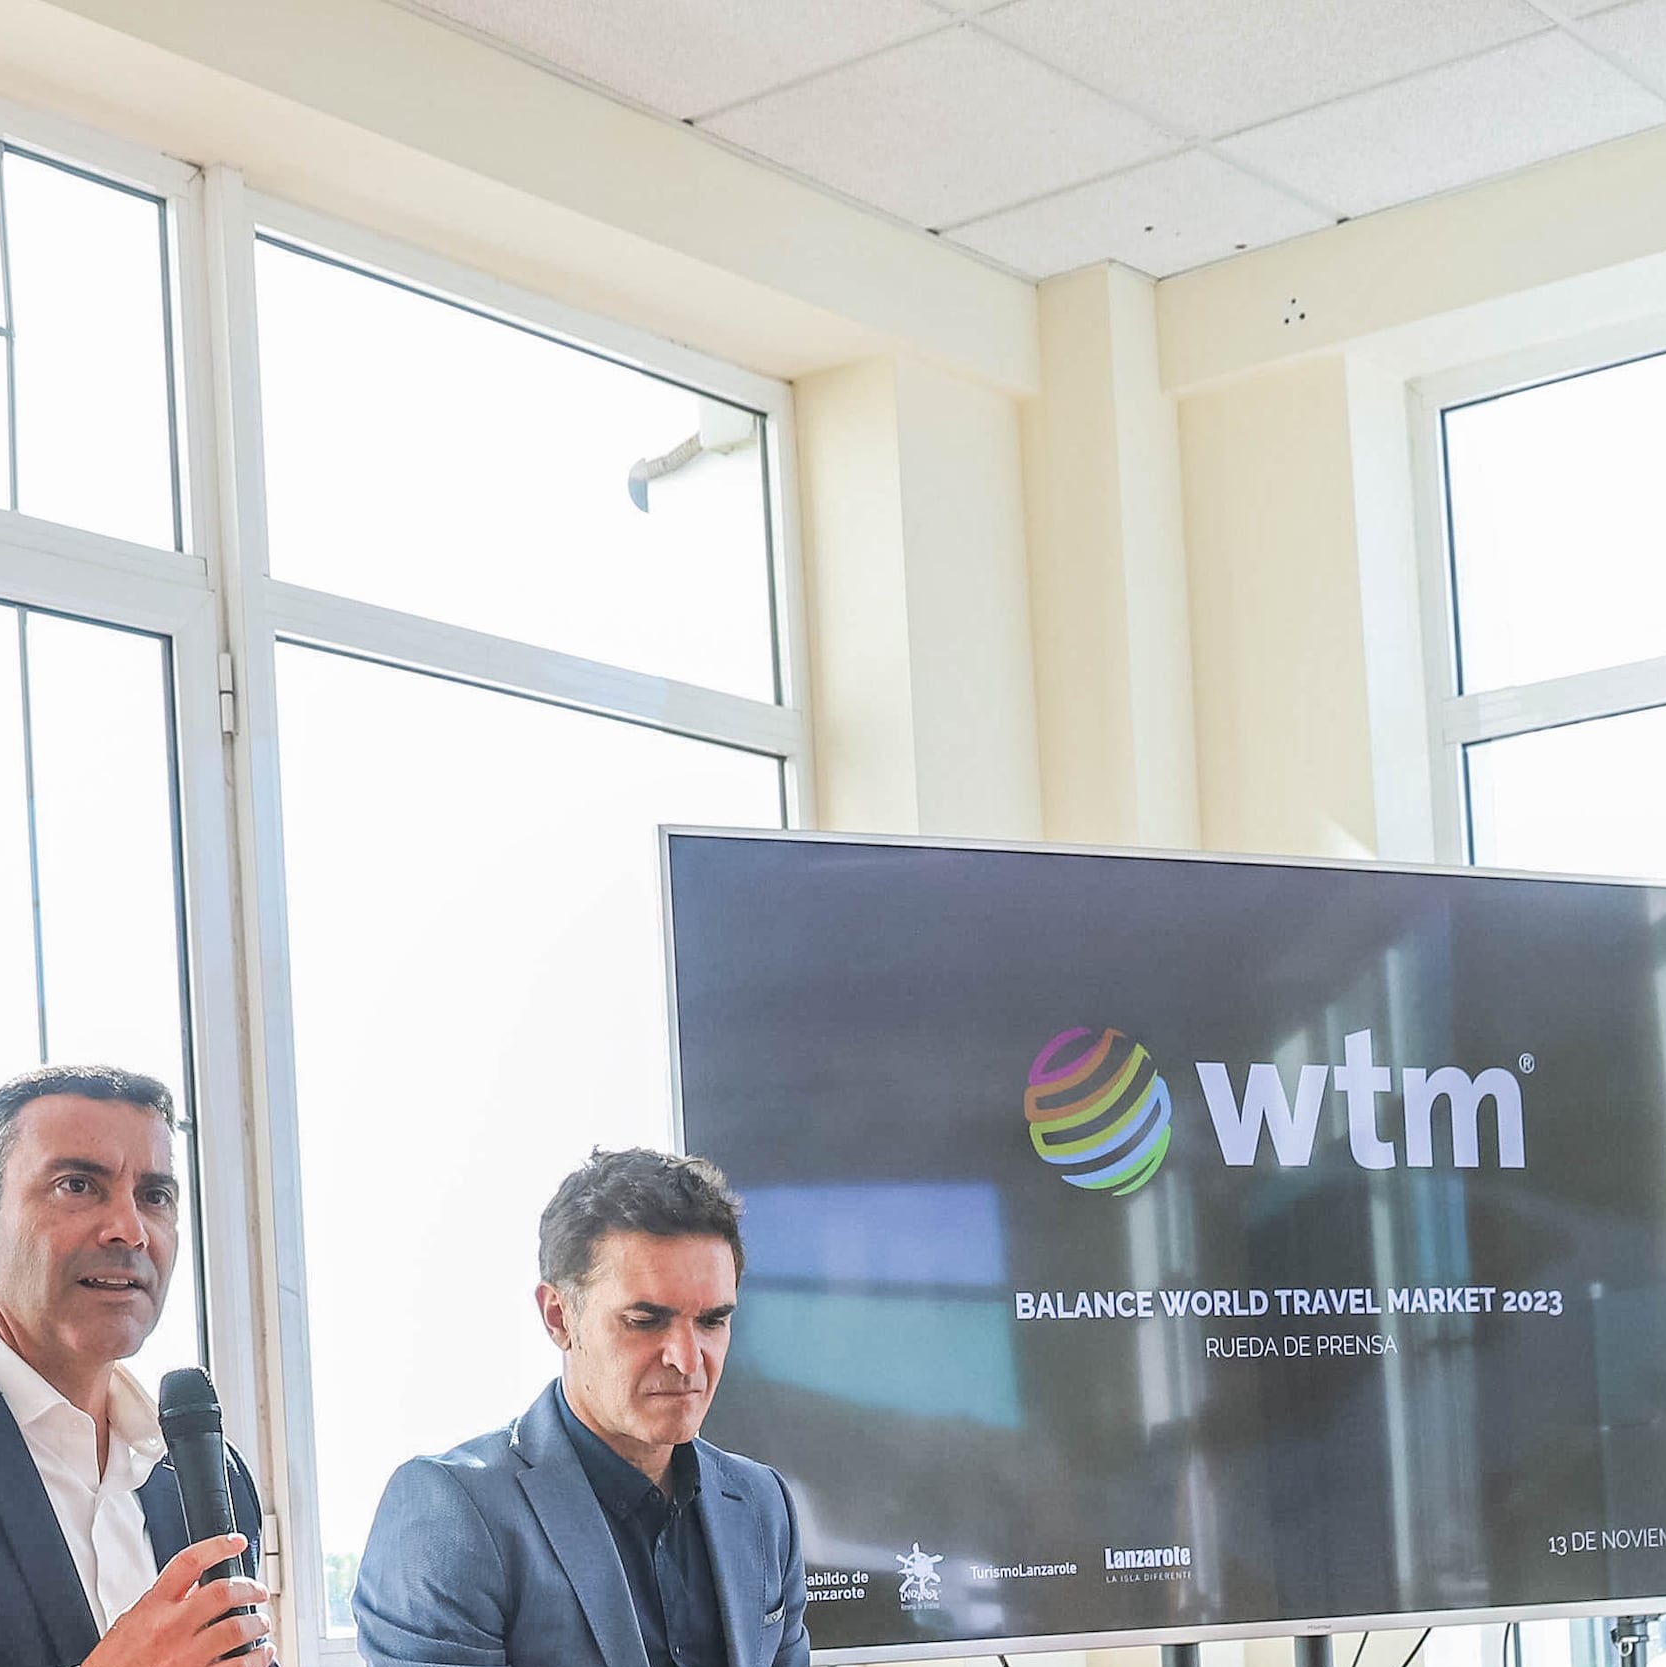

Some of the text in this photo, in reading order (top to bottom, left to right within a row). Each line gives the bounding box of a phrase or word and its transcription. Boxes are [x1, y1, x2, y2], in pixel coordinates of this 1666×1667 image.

[1015, 1286, 1564, 1320] BALANCE WORLD TRAVEL MARKET 2023
[1206, 1334, 1398, 1359] RUEDA DE PRENSA
[1548, 1536, 1568, 1556] 13
[1571, 1531, 1597, 1551] DE
[1104, 1545, 1191, 1570] Lanzarote
[852, 1570, 870, 1584] de
[970, 1562, 1078, 1580] TurismoLanzarote
[1105, 1575, 1118, 1584] LA
[1143, 1570, 1192, 1582] DIFERENTE
[805, 1586, 866, 1602] anzarote
